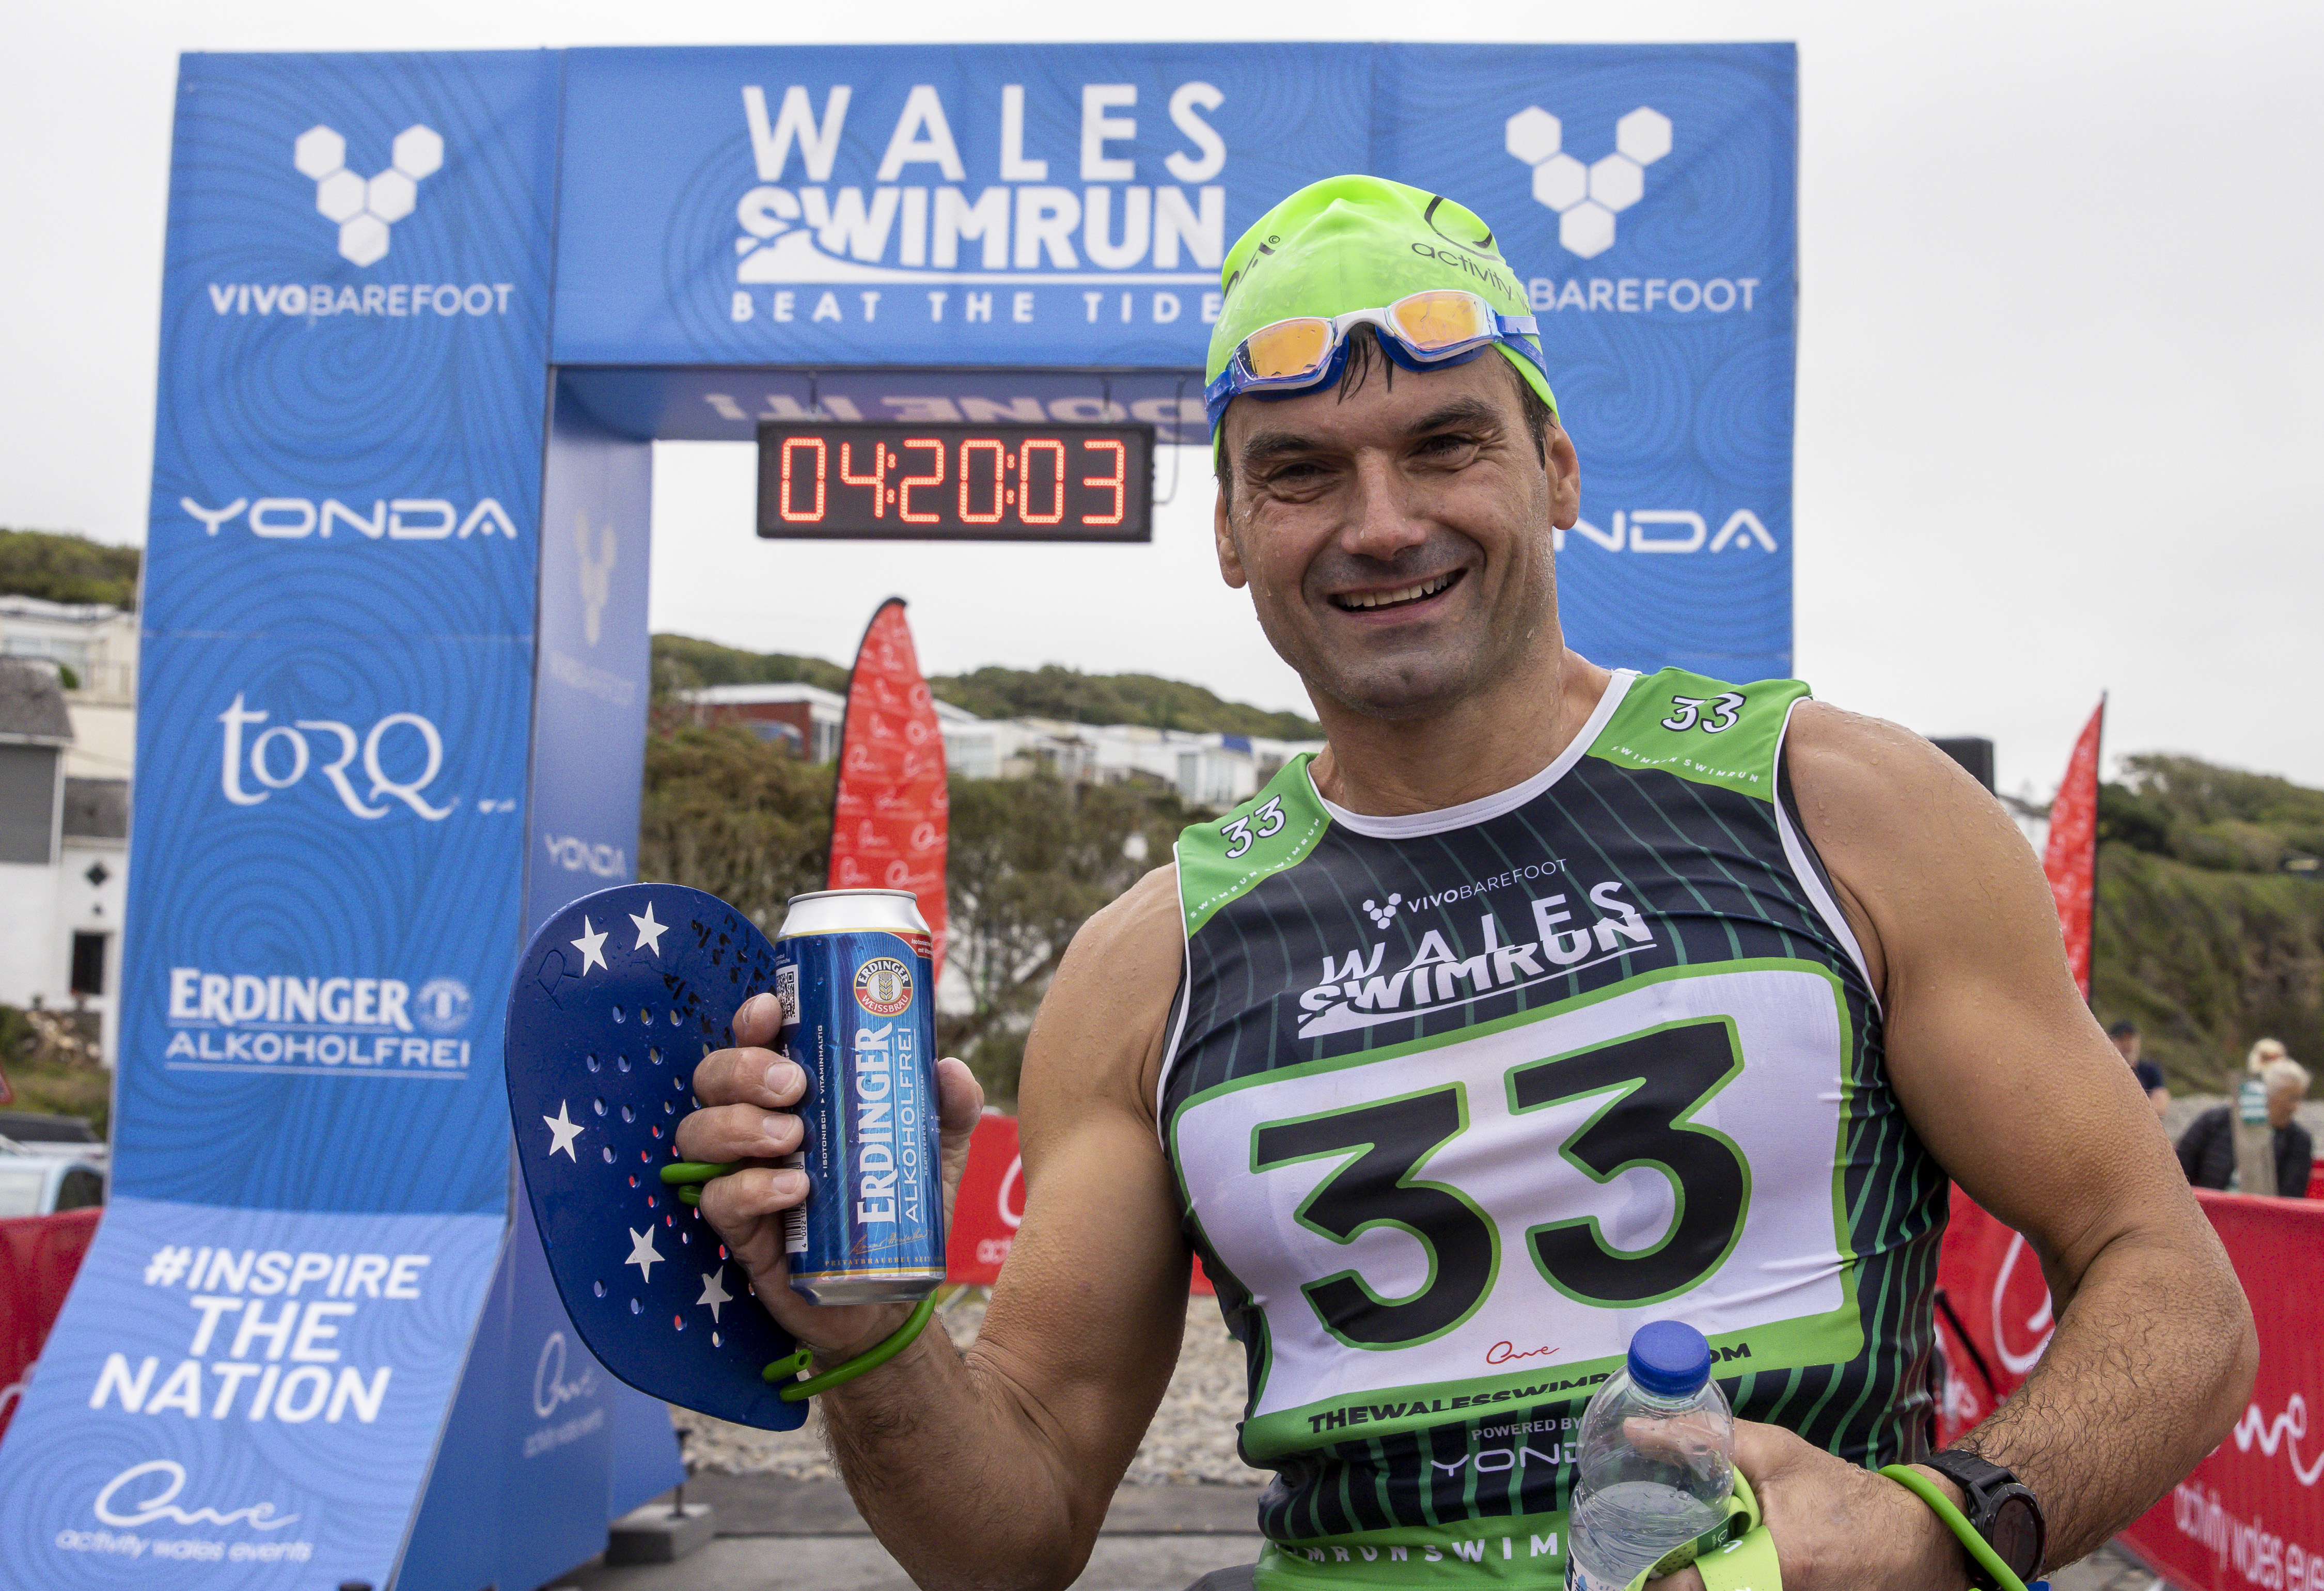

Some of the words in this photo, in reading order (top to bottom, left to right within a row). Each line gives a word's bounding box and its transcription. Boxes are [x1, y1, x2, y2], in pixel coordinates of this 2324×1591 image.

[742, 81, 1227, 182] WALES
[735, 185, 1225, 271] SWIMRUN
[209, 282, 514, 316] VIVOBAREFOOT
[1411, 243, 1512, 301] activity
[1524, 278, 1760, 312] BAREFOOT
[731, 291, 881, 323] BEAT
[928, 291, 1035, 323] THE
[1084, 291, 1222, 323] TIDE
[780, 437, 1125, 524] 04:20:03
[181, 497, 518, 541] YONDA
[1553, 509, 1778, 553] NDA
[1660, 691, 1747, 734] 33
[1219, 794, 1287, 859] 33
[1407, 858, 1567, 913] VIVOBAREFOOT
[1320, 880, 1637, 985] WALES
[857, 960, 909, 984] ERDINGER
[1298, 913, 1653, 1025] SWIMRUN
[168, 966, 414, 1033] ERDINGER
[861, 995, 909, 1014] WEISSBRÄU
[164, 1032, 471, 1068] ALKOHOLFREI
[855, 1021, 899, 1225] ERDINGER
[898, 1028, 920, 1224] ALKOHOLFREI
[1249, 1014, 1753, 1352] 33
[144, 1244, 431, 1299] #INSPIRE
[825, 1255, 910, 1267] PRIVATBRAUEREI
[189, 1295, 357, 1363] THE
[89, 1352, 392, 1424] NATION
[1471, 1418, 1556, 1441] POWERED
[1560, 1416, 1582, 1431] BY
[55, 1529, 151, 1561] activity
[153, 1538, 225, 1562] wales
